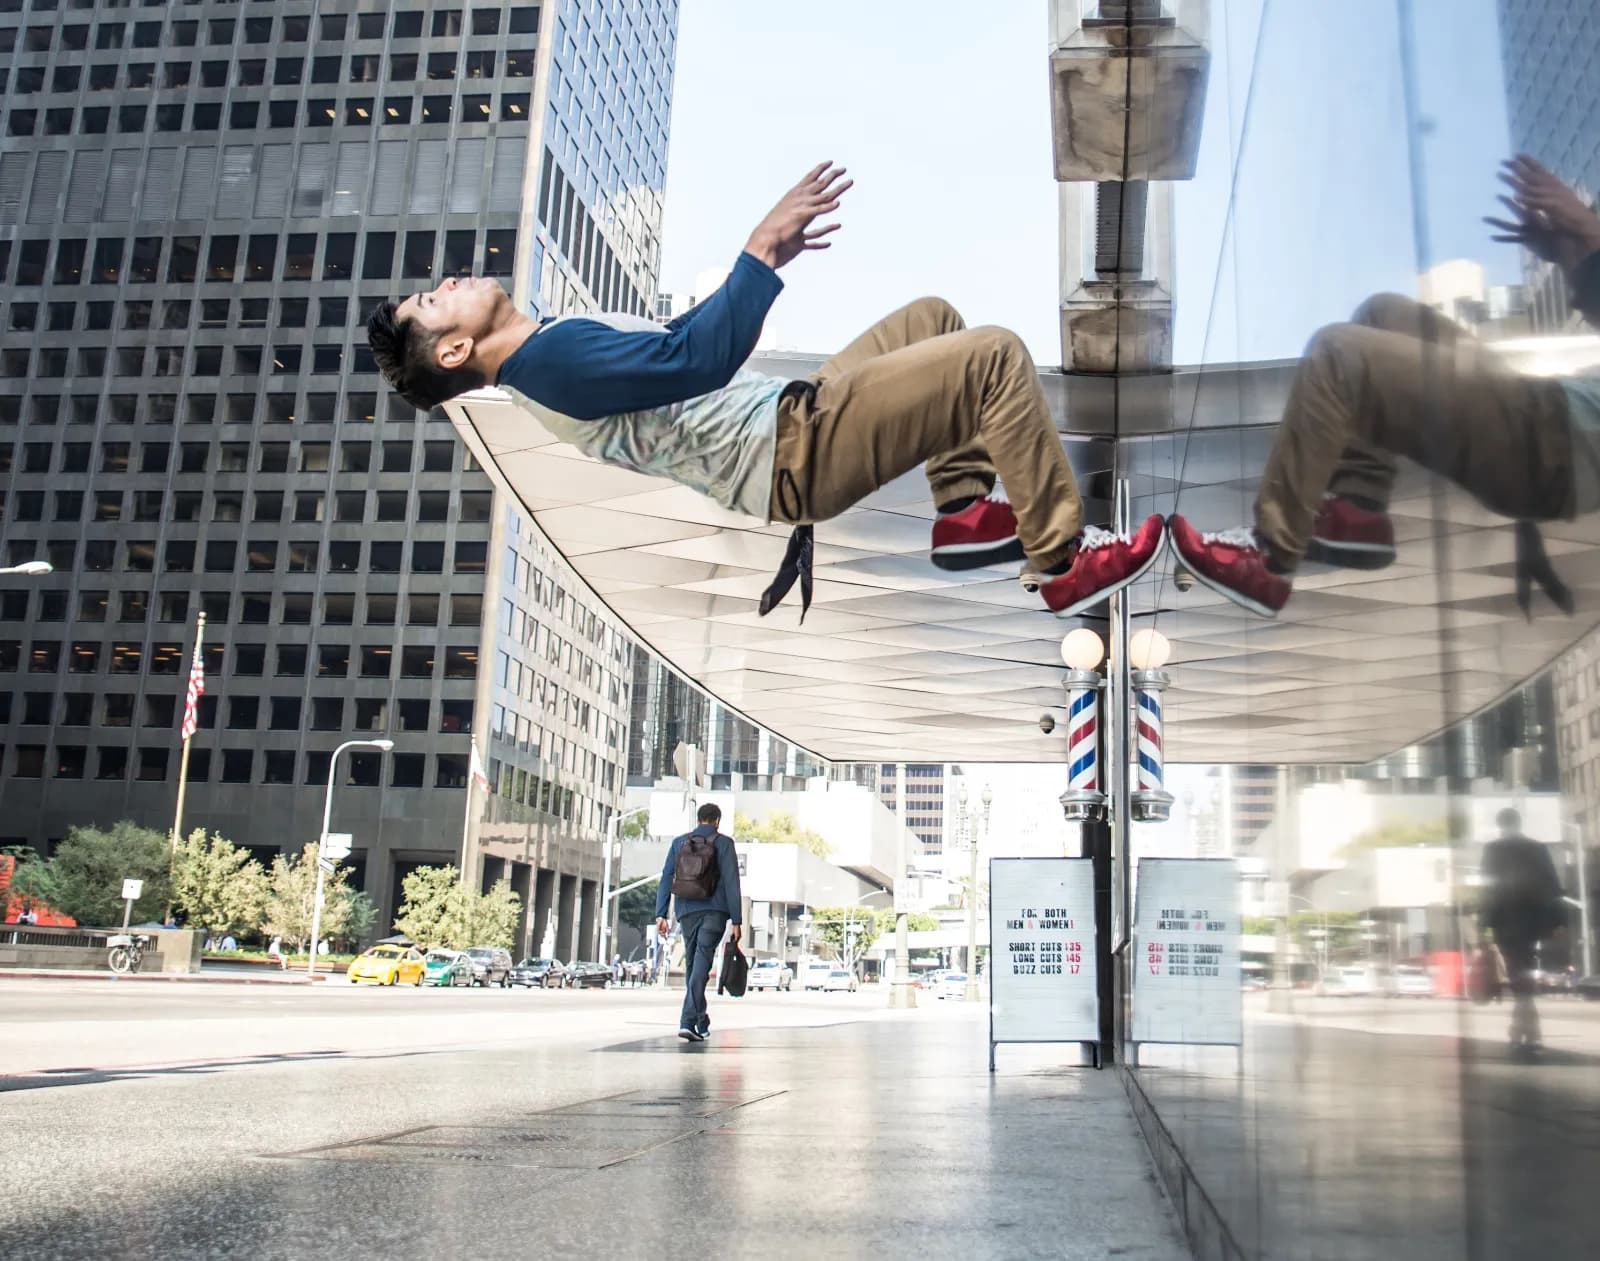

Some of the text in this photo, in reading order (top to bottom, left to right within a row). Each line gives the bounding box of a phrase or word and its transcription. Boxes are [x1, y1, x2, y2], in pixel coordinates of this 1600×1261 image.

[1045, 908, 1067, 918] BOTH
[1007, 919, 1024, 929] MEN
[1009, 942, 1036, 952] SHORT
[1040, 942, 1062, 952] CUTS
[1013, 953, 1035, 963] LONG
[1040, 953, 1062, 963] CUTS
[1013, 965, 1036, 974] BUZZ
[1040, 965, 1062, 974] CUTS
